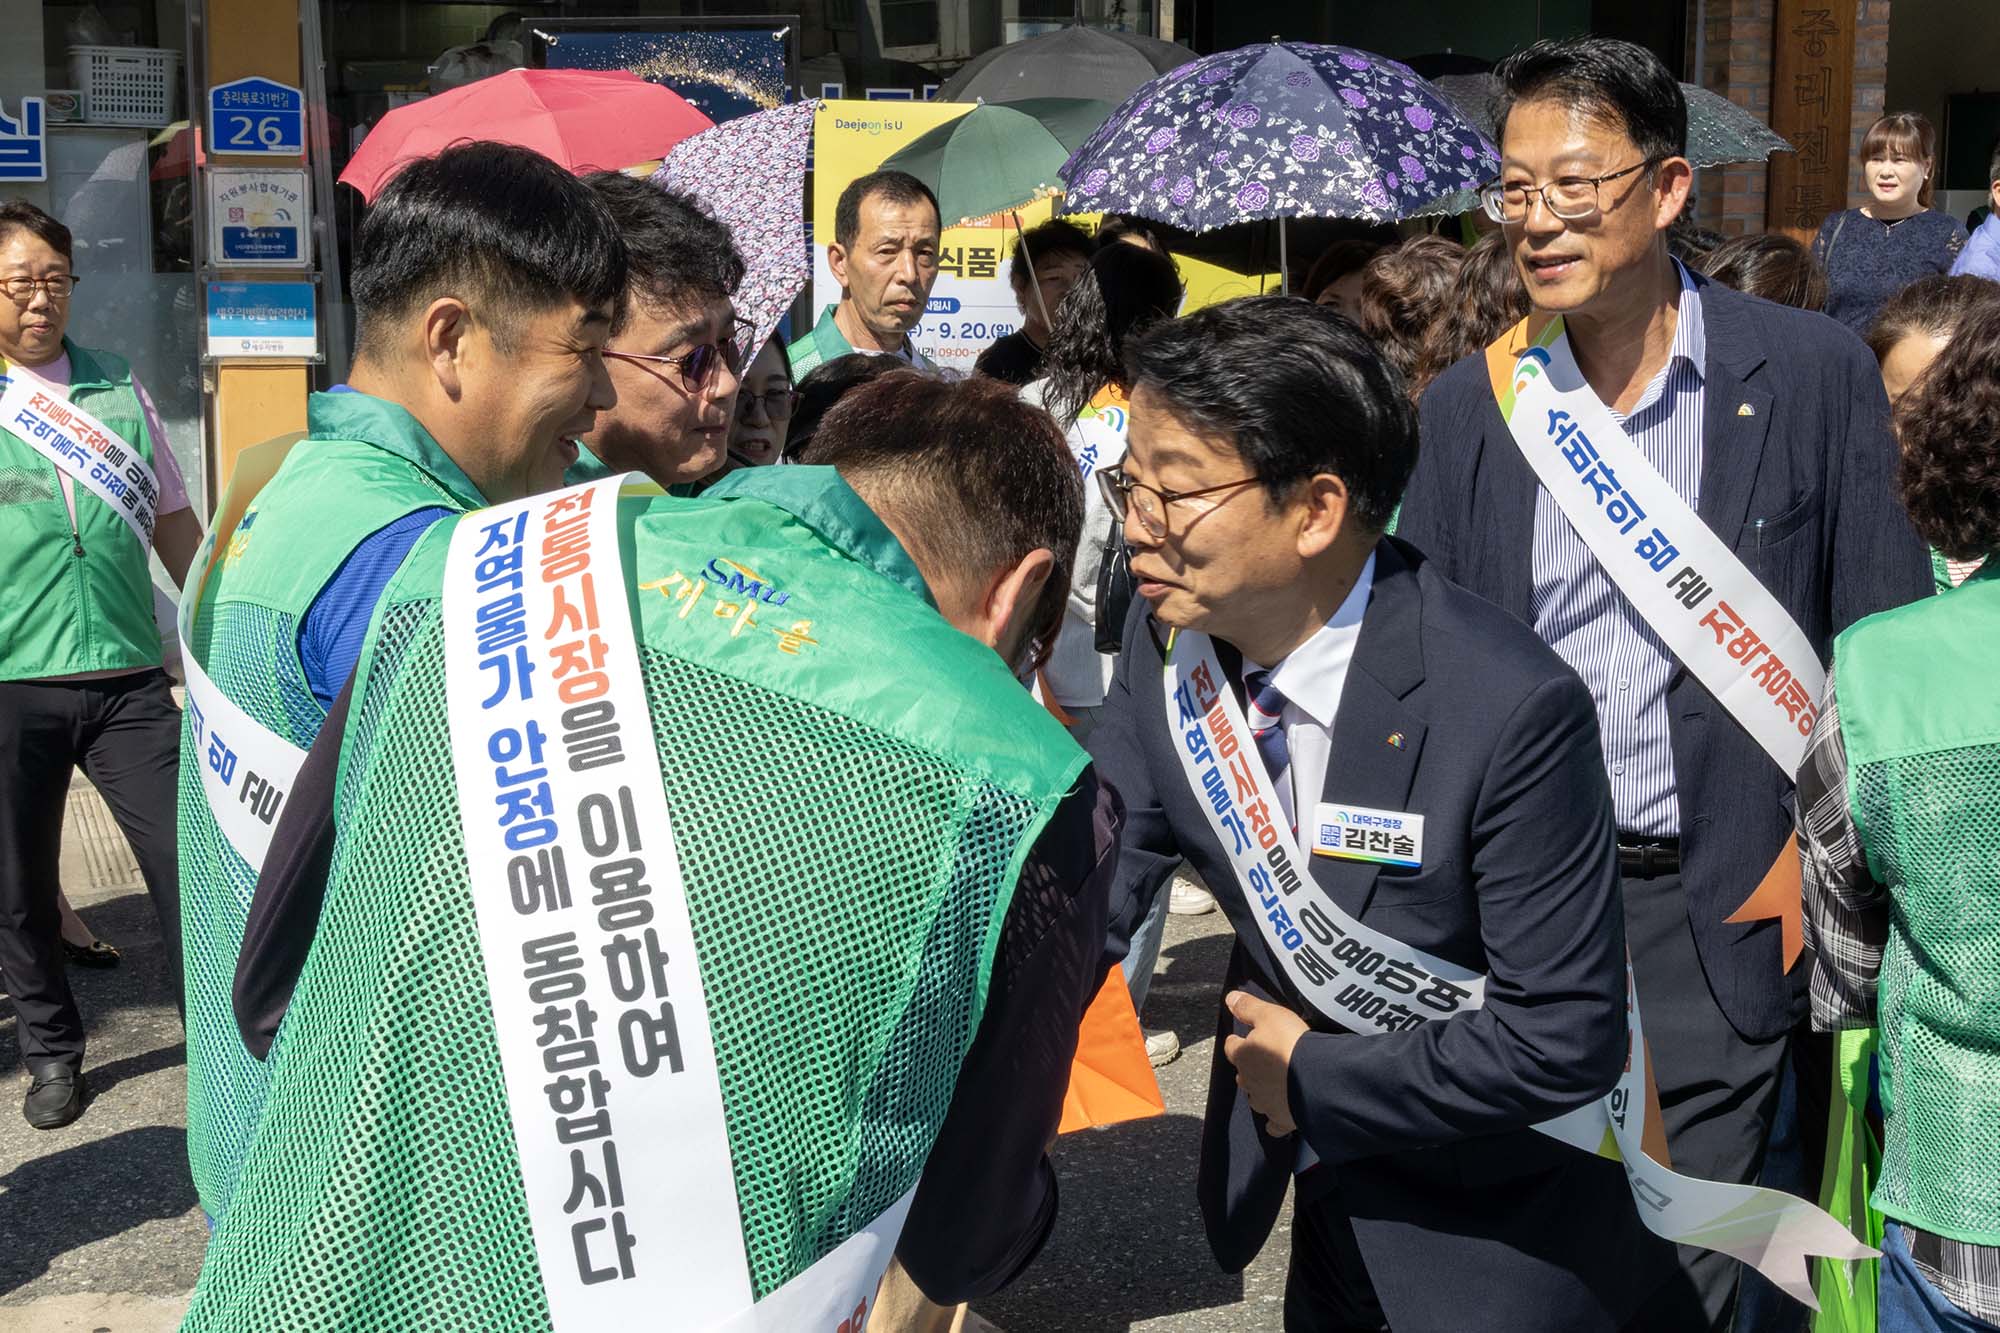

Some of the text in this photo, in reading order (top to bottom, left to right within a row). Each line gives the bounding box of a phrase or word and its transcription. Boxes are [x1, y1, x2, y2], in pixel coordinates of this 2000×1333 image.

[222, 90, 289, 108] 중리북로31번길
[229, 116, 283, 146] 26
[835, 118, 903, 136] Daejeon is U
[15, 409, 92, 469] 지역물가
[90, 462, 140, 511] 안정에
[29, 392, 128, 468] 전통시장을
[1546, 408, 1648, 535] 소비자의
[1634, 528, 1681, 573] 힘
[638, 569, 819, 655] 새마을
[701, 558, 791, 606] SMU
[209, 730, 239, 787] 힘
[540, 487, 685, 1079] 전통시장을 이용하여
[1173, 680, 1252, 857] 지역물가
[1248, 861, 1340, 987] 안정에
[1191, 659, 1473, 1013] 전통시장을 이용하여
[1345, 828, 1415, 857] 김찬술
[1352, 814, 1403, 830] 대덕구청장
[474, 510, 637, 1287] 지역물가 안정에 동참합시다
